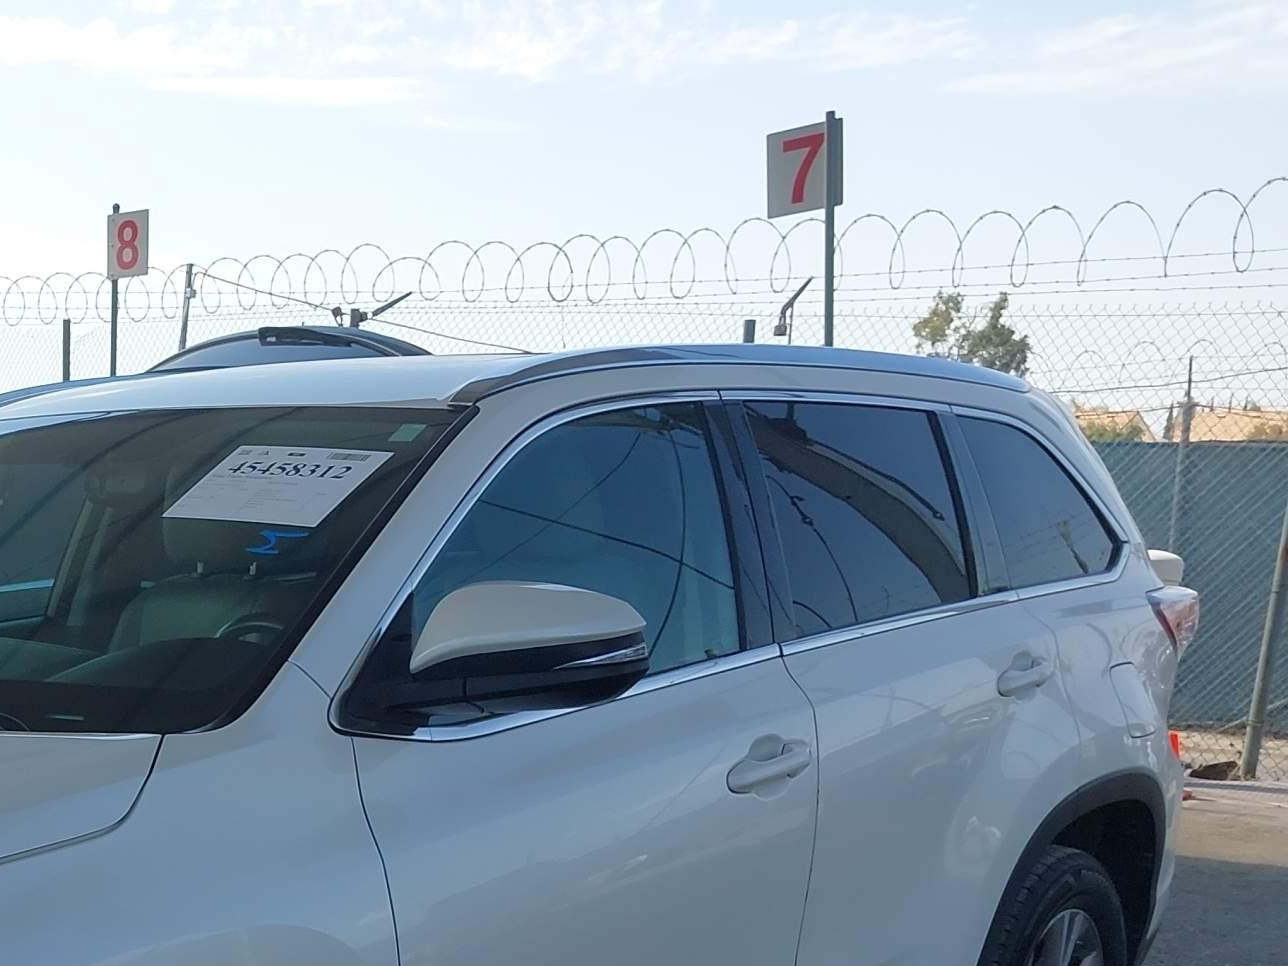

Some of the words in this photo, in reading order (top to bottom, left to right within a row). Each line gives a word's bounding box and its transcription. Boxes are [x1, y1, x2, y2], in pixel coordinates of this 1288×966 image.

[782, 132, 825, 205] 7
[116, 219, 140, 271] 8
[228, 460, 354, 480] 45458312
